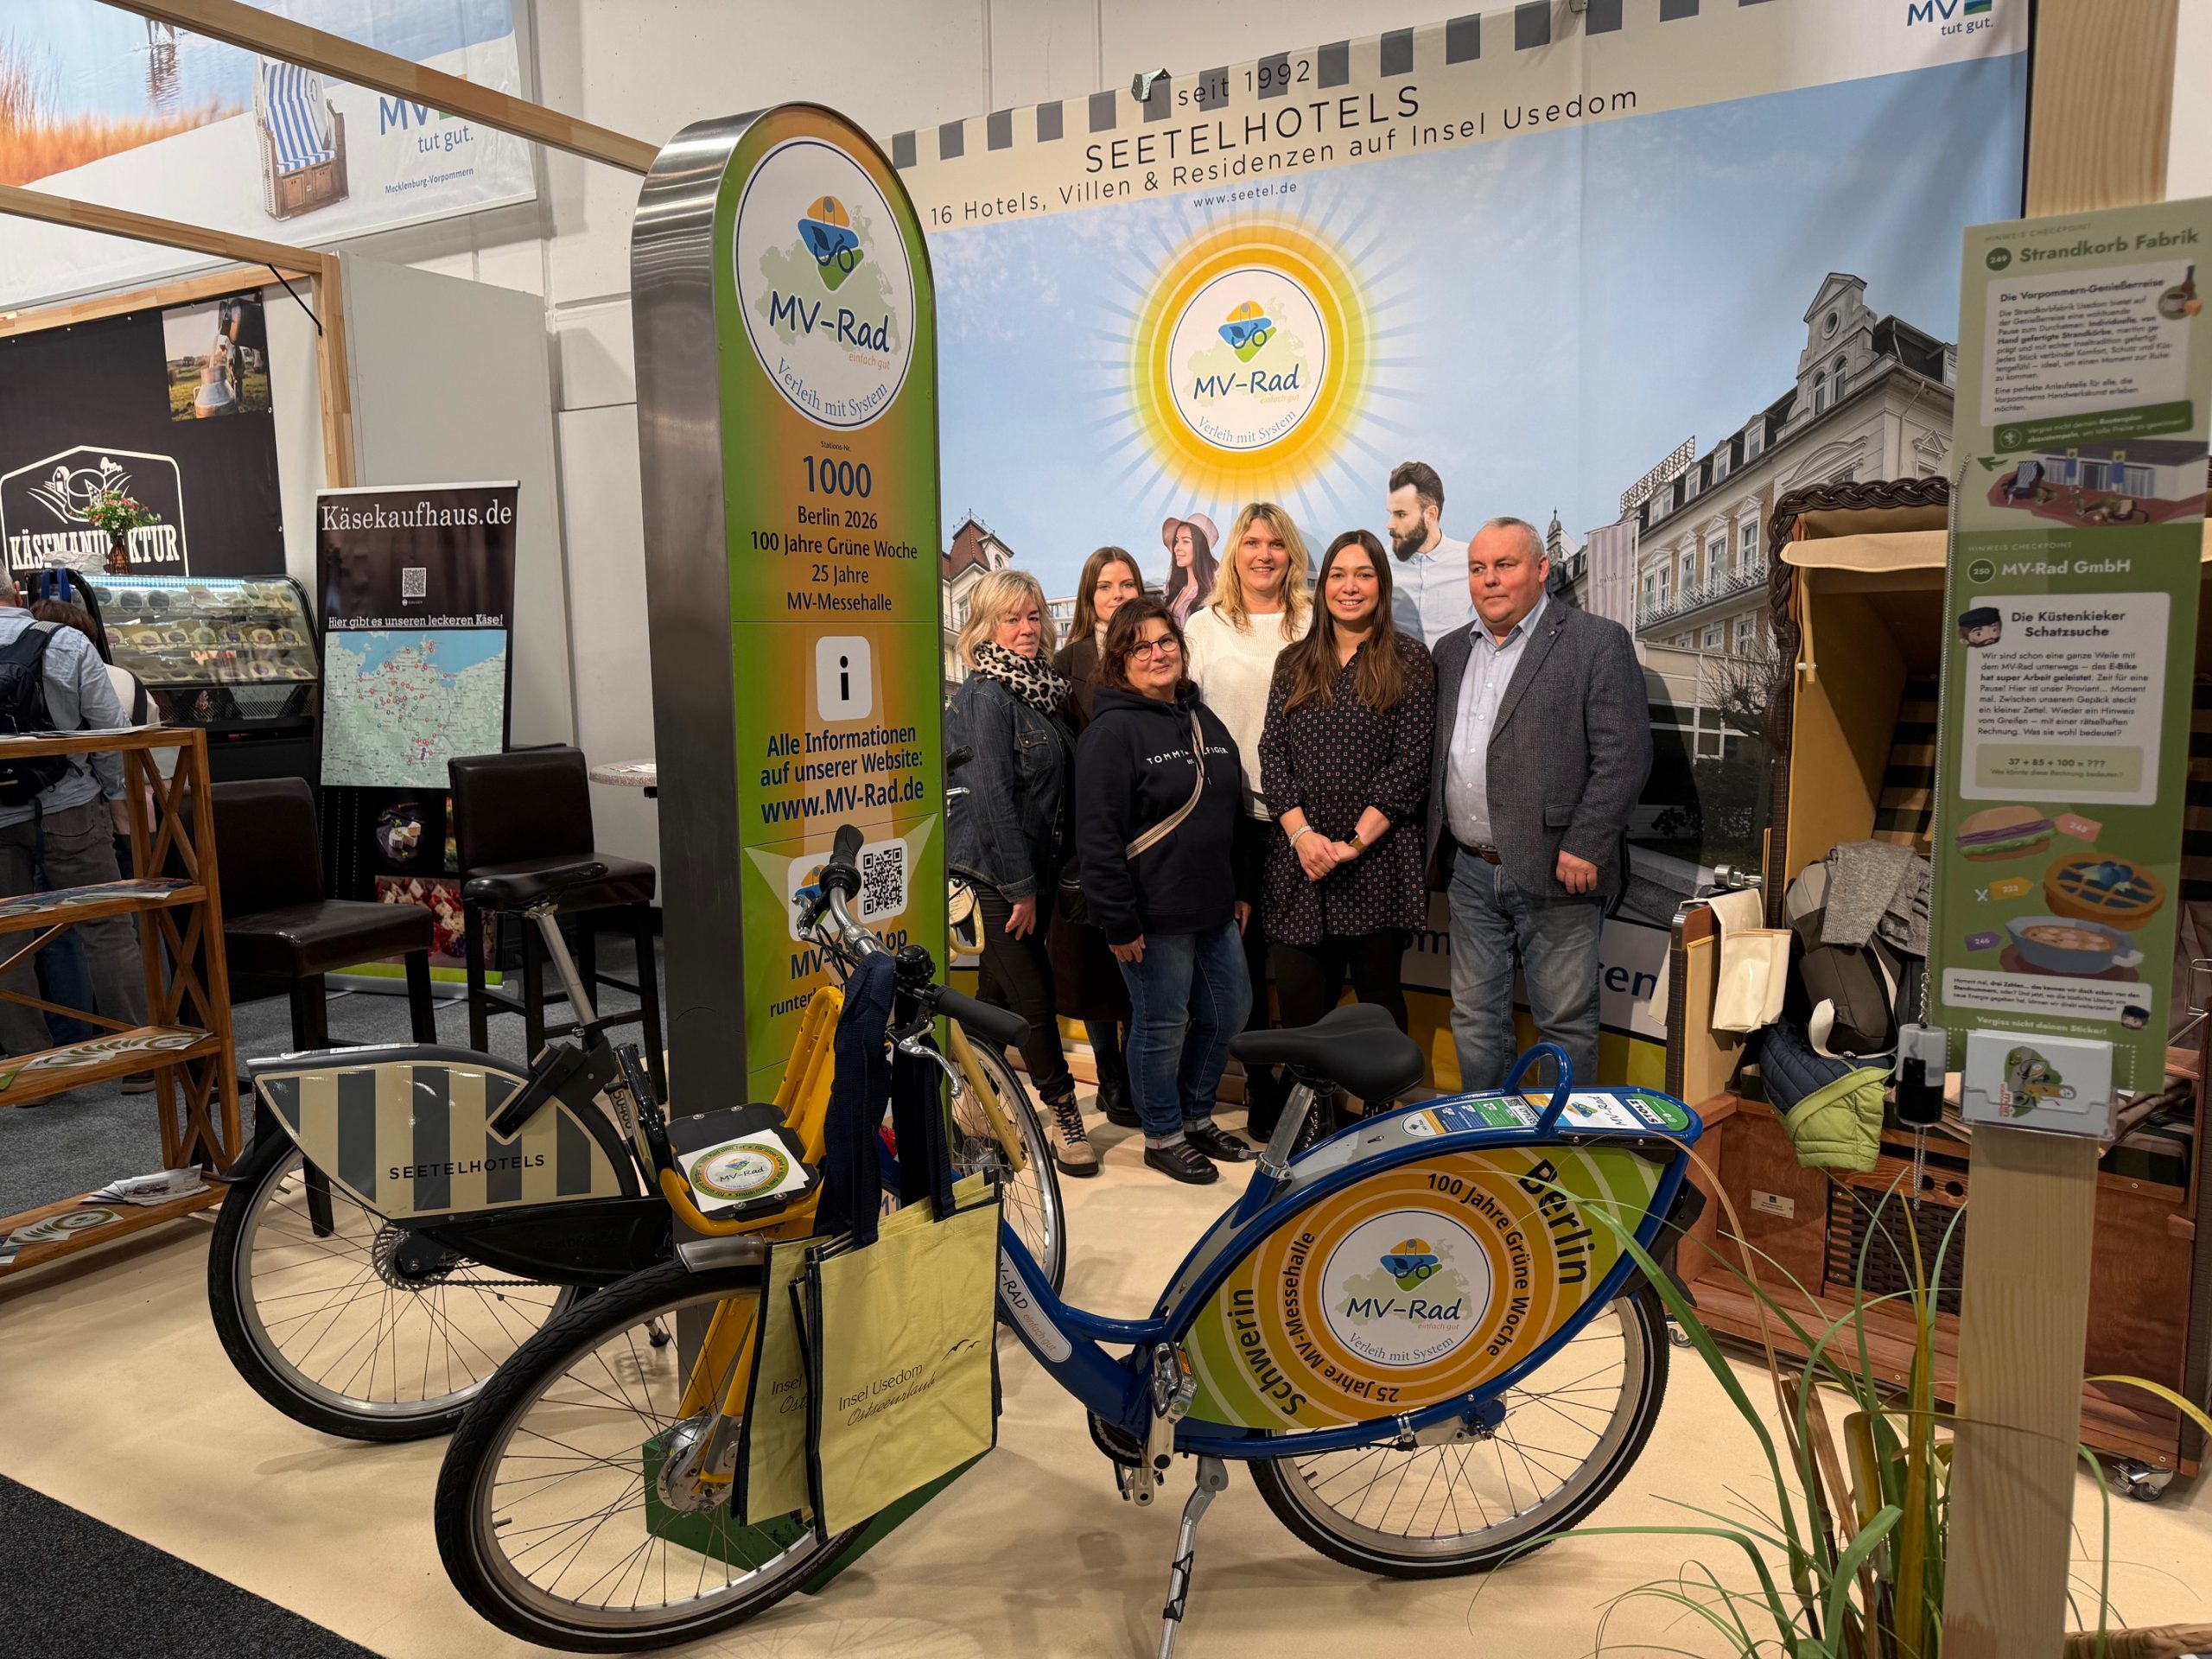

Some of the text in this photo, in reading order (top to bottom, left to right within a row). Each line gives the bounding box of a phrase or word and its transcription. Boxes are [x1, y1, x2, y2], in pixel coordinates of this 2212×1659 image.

[1907, 0, 1958, 26] MV
[1941, 17, 1993, 35] tut gut.
[1178, 60, 1311, 106] seit 1992
[380, 96, 429, 136] MV
[1085, 86, 1420, 173] SEETELHOTELS
[418, 124, 474, 153] tut gut.
[931, 90, 1637, 226] 16 Hotels, Villen & Residenzen auf Insel Usedom
[385, 168, 474, 194] Mecklenburg-Vorpommern
[1193, 181, 1297, 208] www.seetel.de
[2019, 237, 2129, 263] Strandkorb
[2136, 228, 2199, 251] Fabrik
[1999, 292, 2018, 302] Die
[769, 290, 890, 353] MV-Rad
[849, 353, 891, 371] einfach gut
[778, 357, 888, 420] Verleih mit System
[1193, 363, 1300, 400] MV-Rad
[1260, 394, 1300, 404] einfach gut
[1199, 410, 1297, 444] Verleih mit System
[803, 455, 872, 498] 1000
[321, 499, 512, 531] Käsekaufhaus.de
[798, 505, 878, 529] Berlin 2026
[751, 531, 918, 559] 100 Jahre Grüne Woche
[2012, 541, 2072, 550] CHECKPOINT
[811, 564, 869, 586] 25 Jahre
[2002, 560, 2068, 575] MV-Rad
[2074, 559, 2131, 574] GmbH
[787, 592, 892, 611] MV-Messehalle
[328, 613, 504, 629] Hier gibt es unseren leckeren Käse!
[2012, 610, 2126, 622] Die Küstenkieker
[2025, 626, 2109, 637] Schatzsuche
[766, 725, 916, 758] Alle Informationen
[760, 750, 923, 787] auf unserer Website:
[760, 776, 924, 824] www.MV-Rad.de
[1977, 1016, 2009, 1027] Vergiss
[2012, 1020, 2034, 1028] nicht
[1630, 1100, 1659, 1124] STOLZ
[389, 1154, 545, 1180] SEETELHOTELS
[720, 1166, 765, 1183] MV-Rad
[1517, 1158, 1596, 1285] Berlin
[1427, 1173, 1530, 1357] 100 Jahre Grüne Woche
[1282, 1231, 1400, 1402] 25 Jahre MV-Messehalle
[1345, 1297, 1463, 1320] MV-Rad
[1417, 1322, 1459, 1332] einfach gut
[1227, 1288, 1307, 1415] Schwerin
[1348, 1332, 1454, 1362] Verleih mit System
[772, 1374, 803, 1395] Insel
[839, 1364, 923, 1411] Insel Usedom
[847, 1371, 936, 1427] Ostseeurlaub
